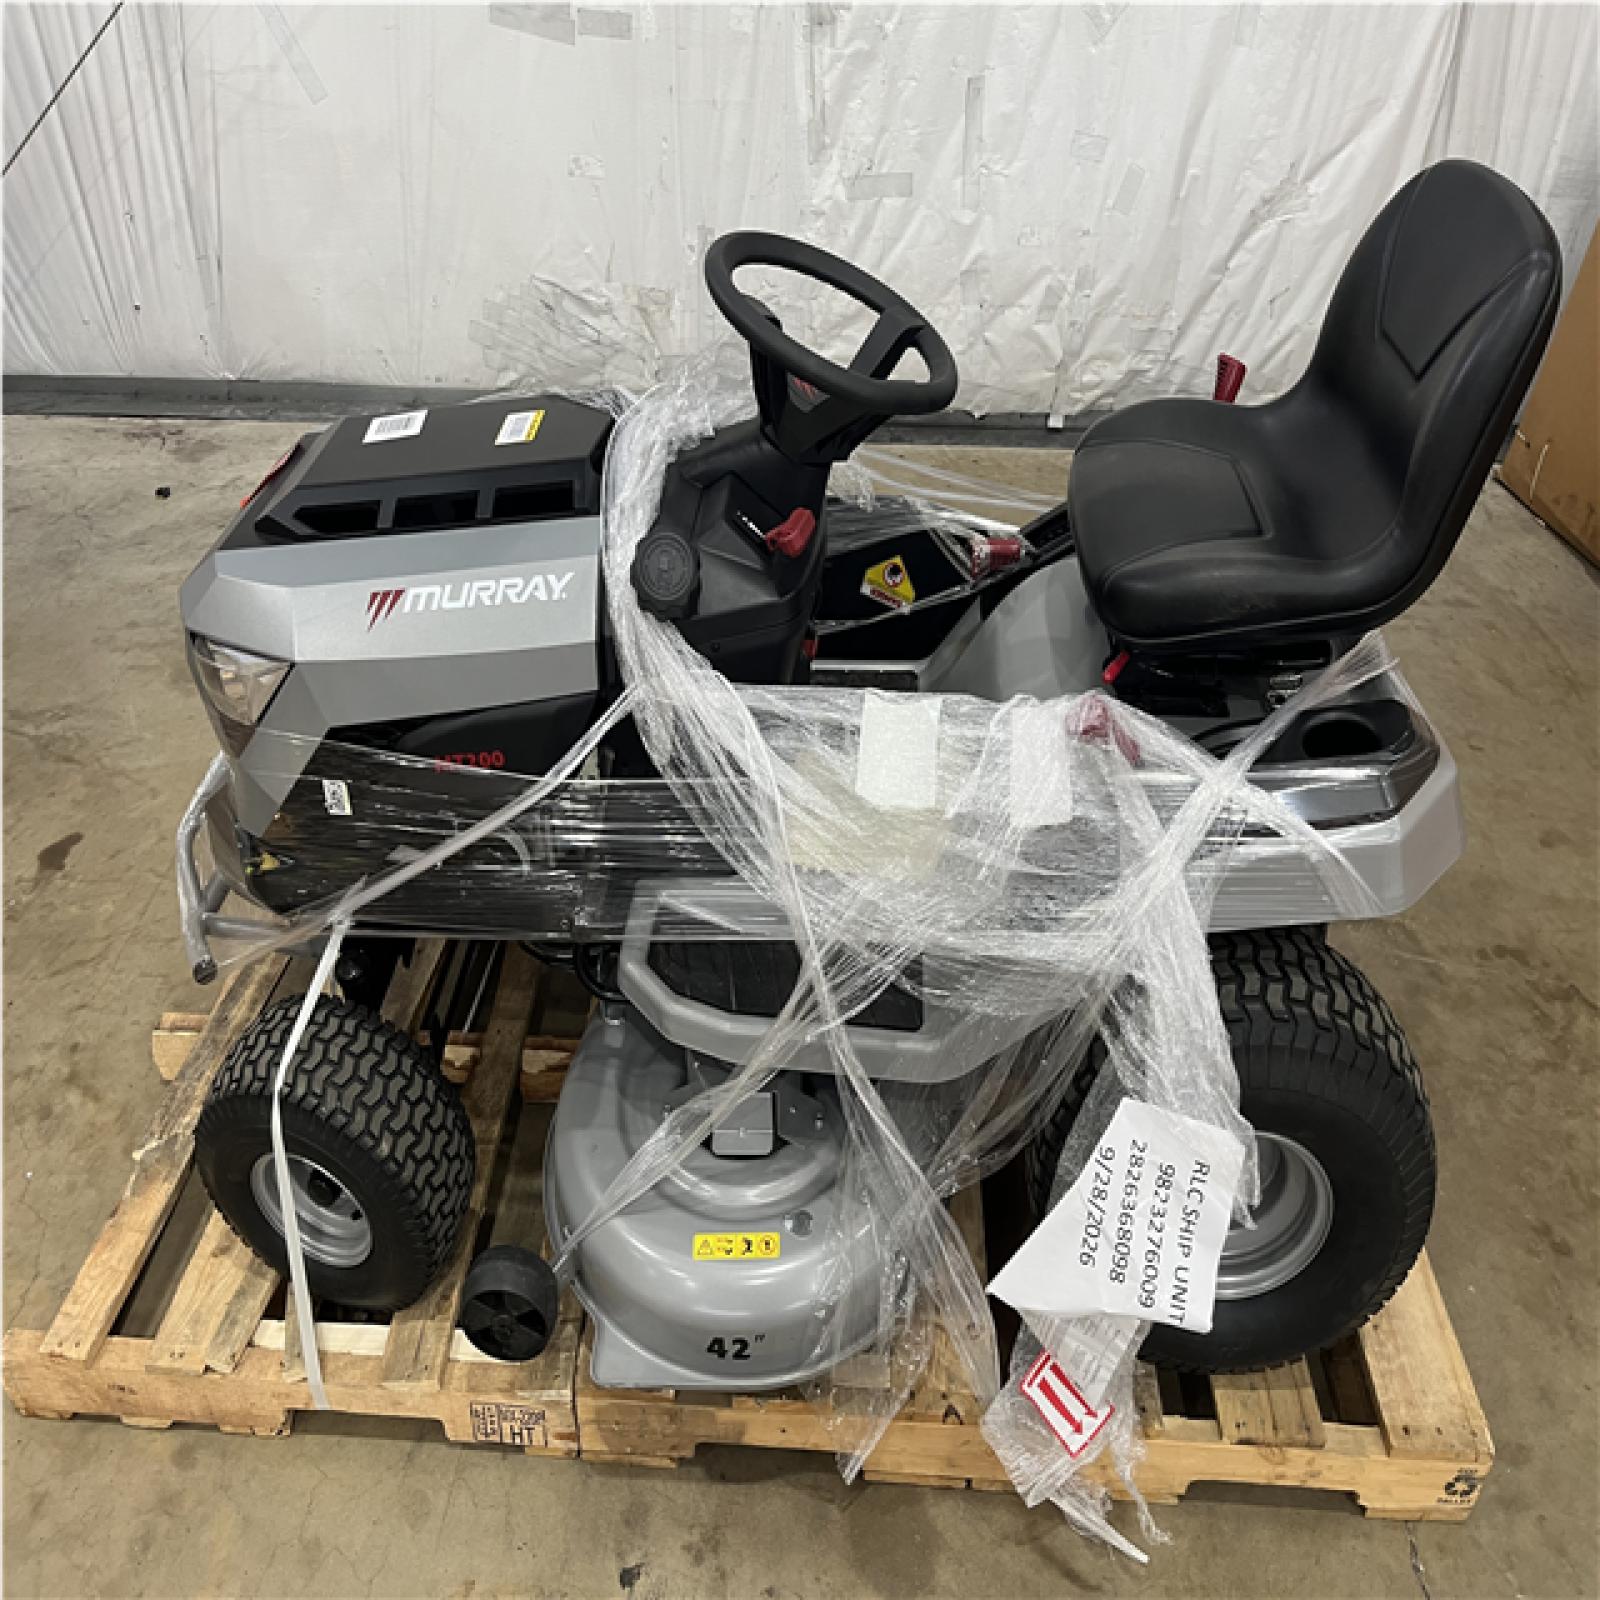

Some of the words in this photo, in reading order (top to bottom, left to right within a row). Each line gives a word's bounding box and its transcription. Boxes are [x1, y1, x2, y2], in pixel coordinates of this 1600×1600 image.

[403, 571, 576, 613] MURRAY
[1079, 1146, 1116, 1268] 9/28/2026
[1187, 1159, 1211, 1204] RLC
[1109, 1139, 1149, 1284] 2826368098
[1177, 1205, 1201, 1259] SHIP
[1168, 1264, 1189, 1324] UNIT
